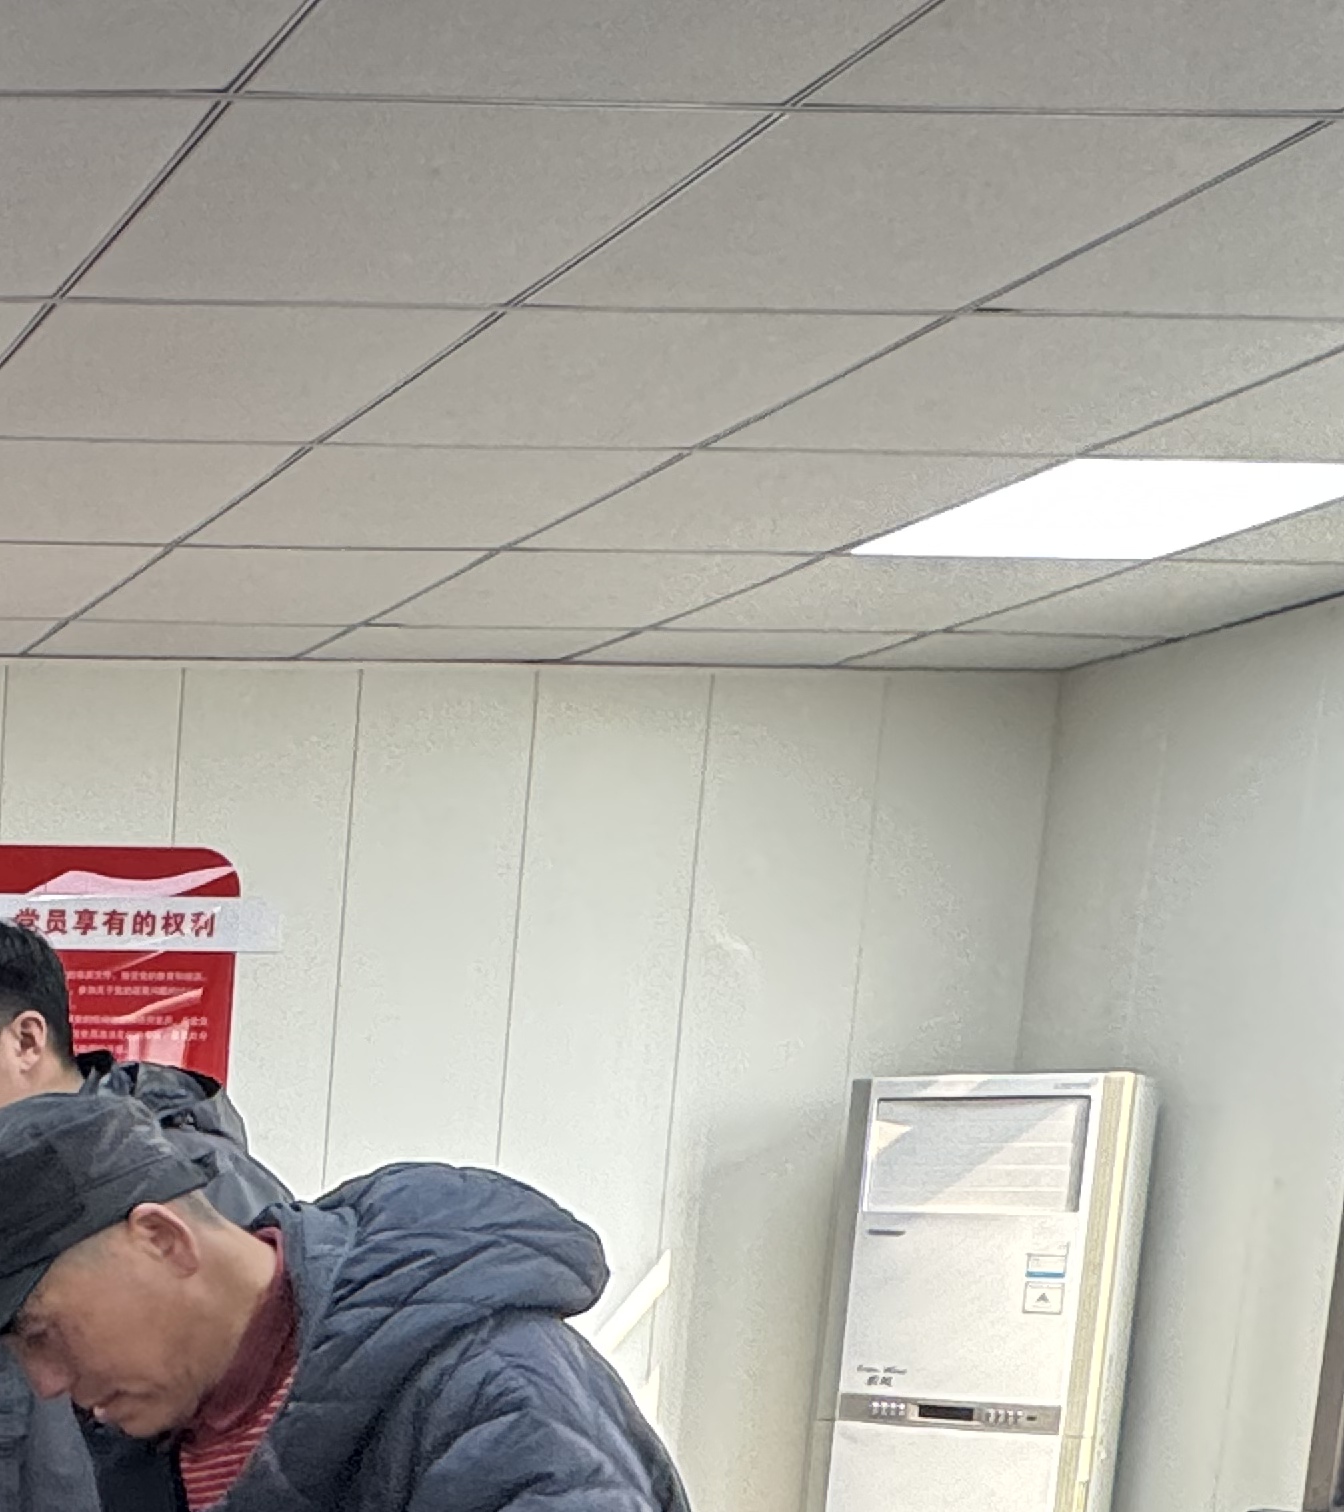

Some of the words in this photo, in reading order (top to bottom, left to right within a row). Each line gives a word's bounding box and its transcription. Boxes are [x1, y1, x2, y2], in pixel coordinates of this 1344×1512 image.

[14, 907, 217, 938] 党员享有的权利
